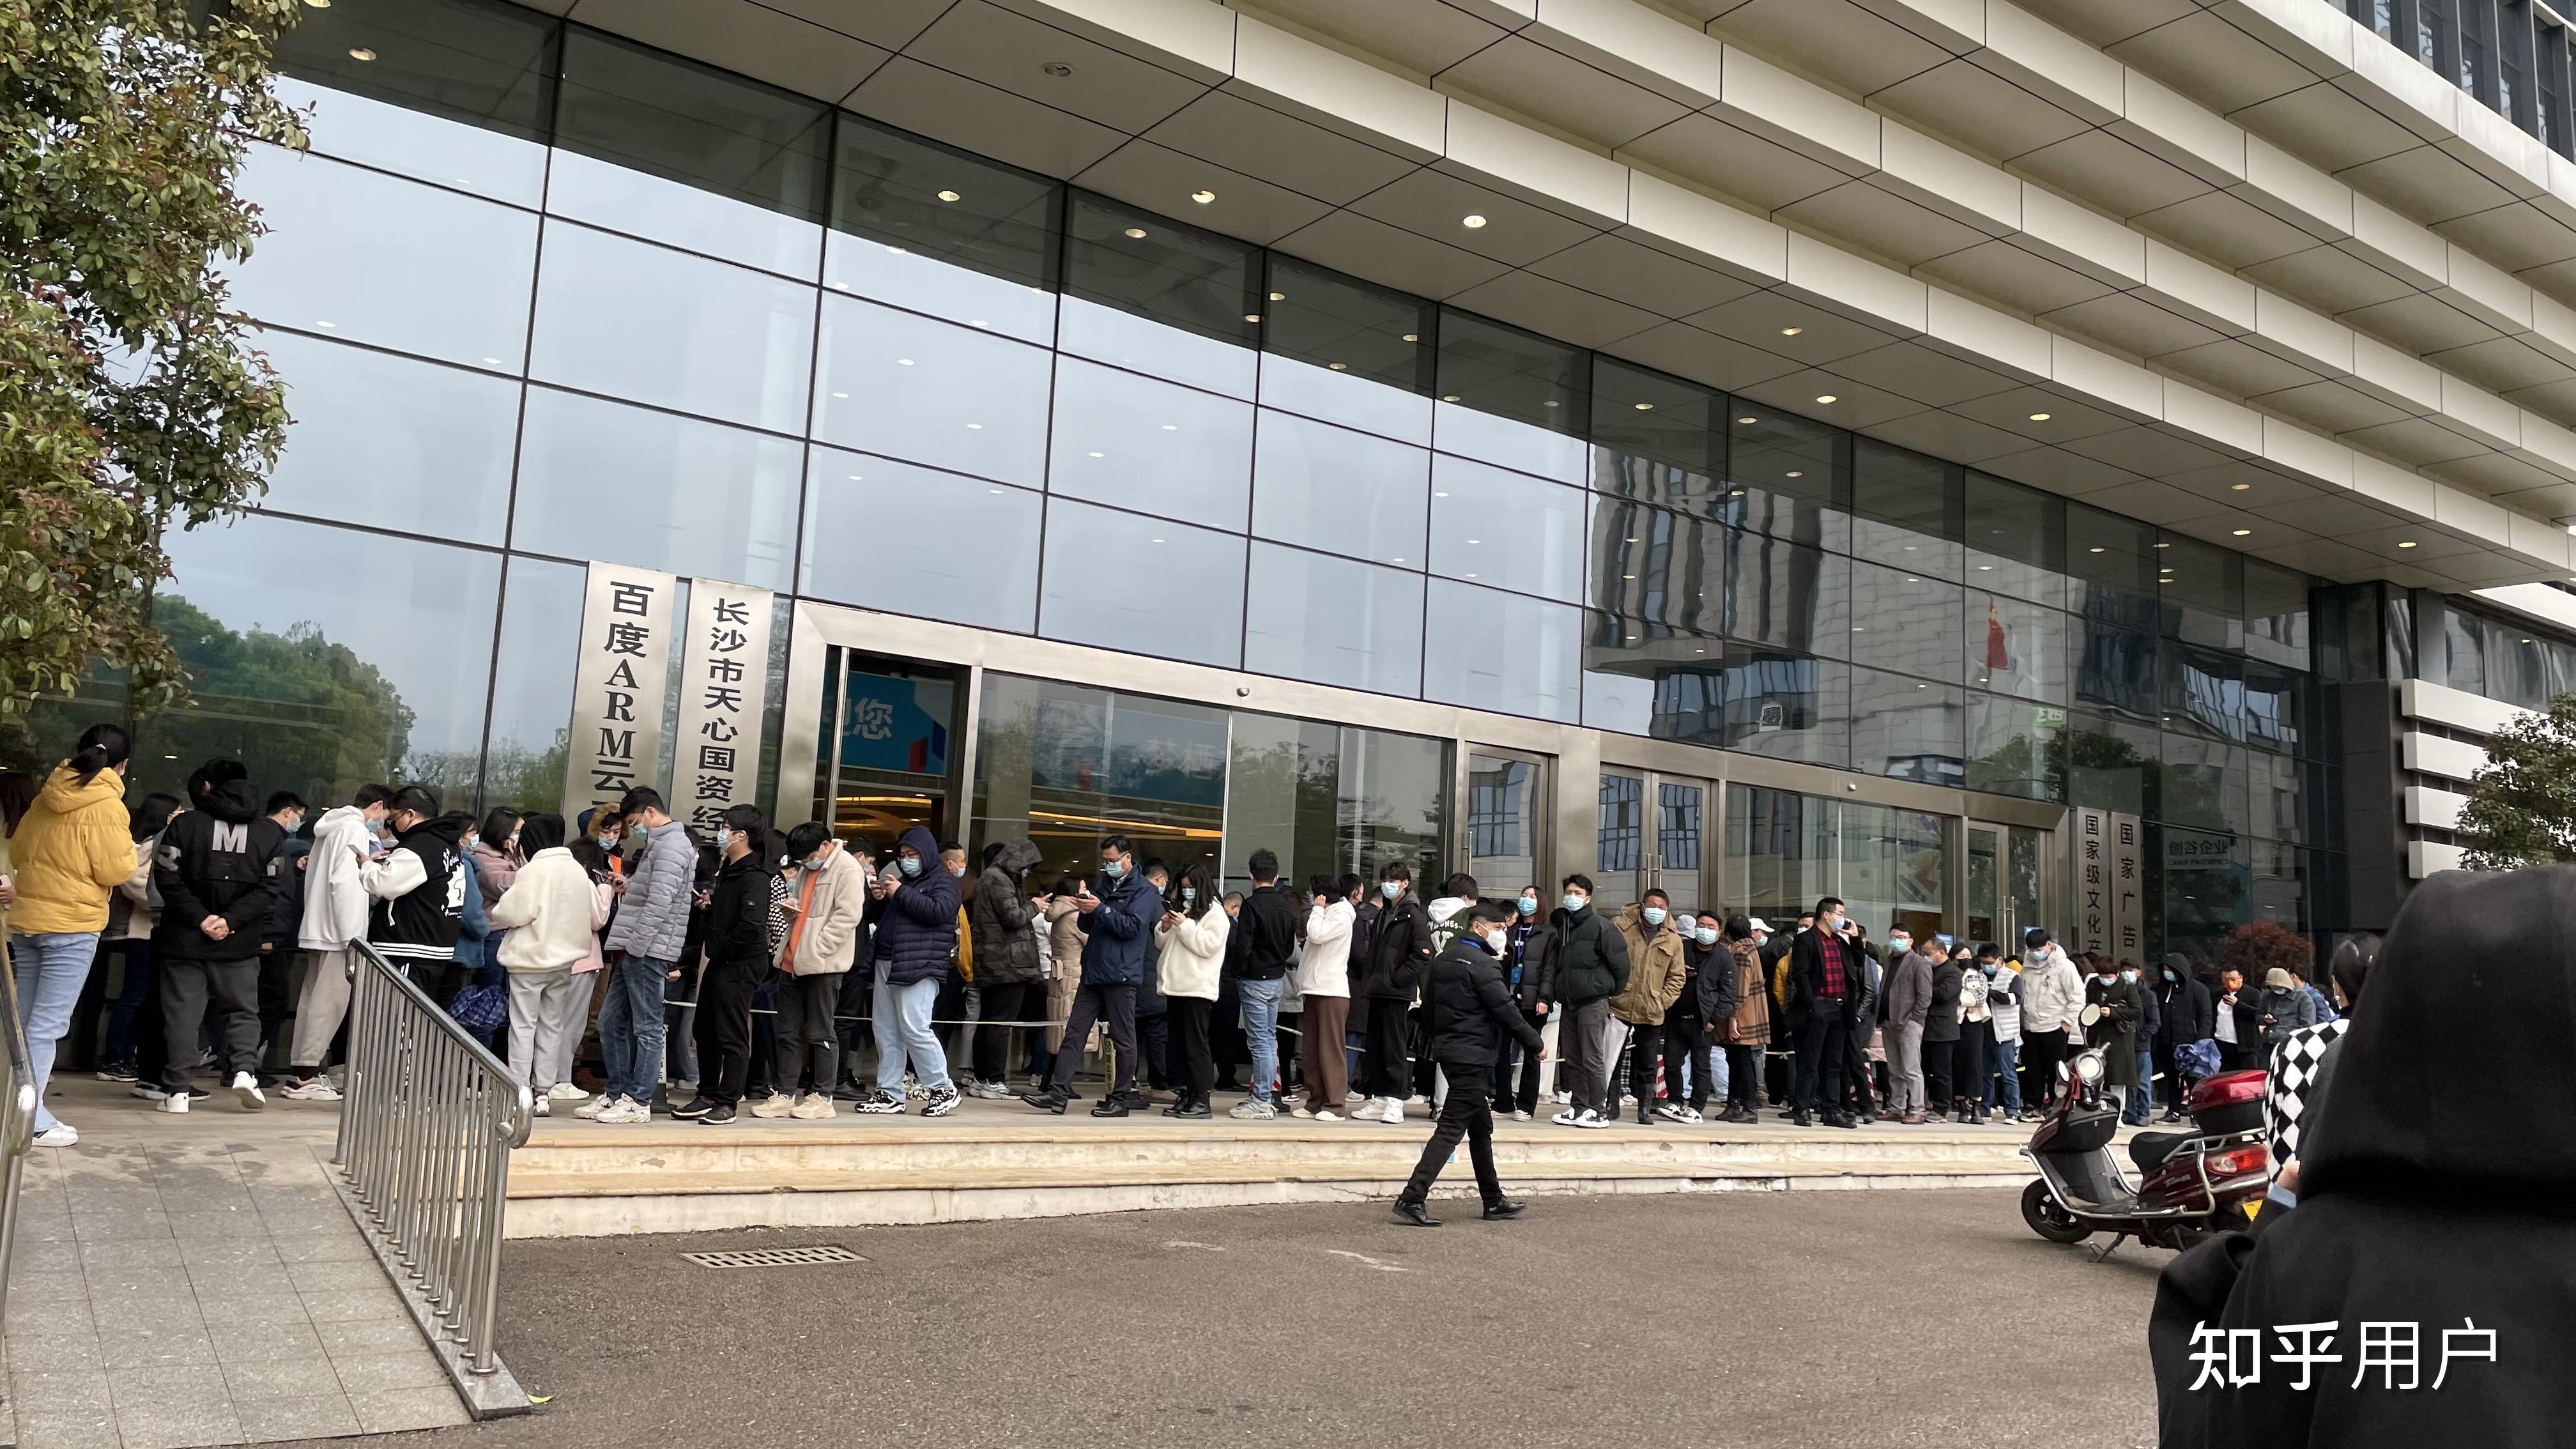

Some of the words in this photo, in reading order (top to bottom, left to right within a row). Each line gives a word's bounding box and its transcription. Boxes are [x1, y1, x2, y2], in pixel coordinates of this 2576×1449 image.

[591, 581, 654, 806] 百度ARM云
[691, 597, 750, 845] 长沙市天心国资经
[212, 819, 248, 854] M
[2085, 815, 2101, 953] 国家级文化产
[2120, 822, 2136, 948] 国家广告
[2168, 839, 2228, 855] 创谷企业
